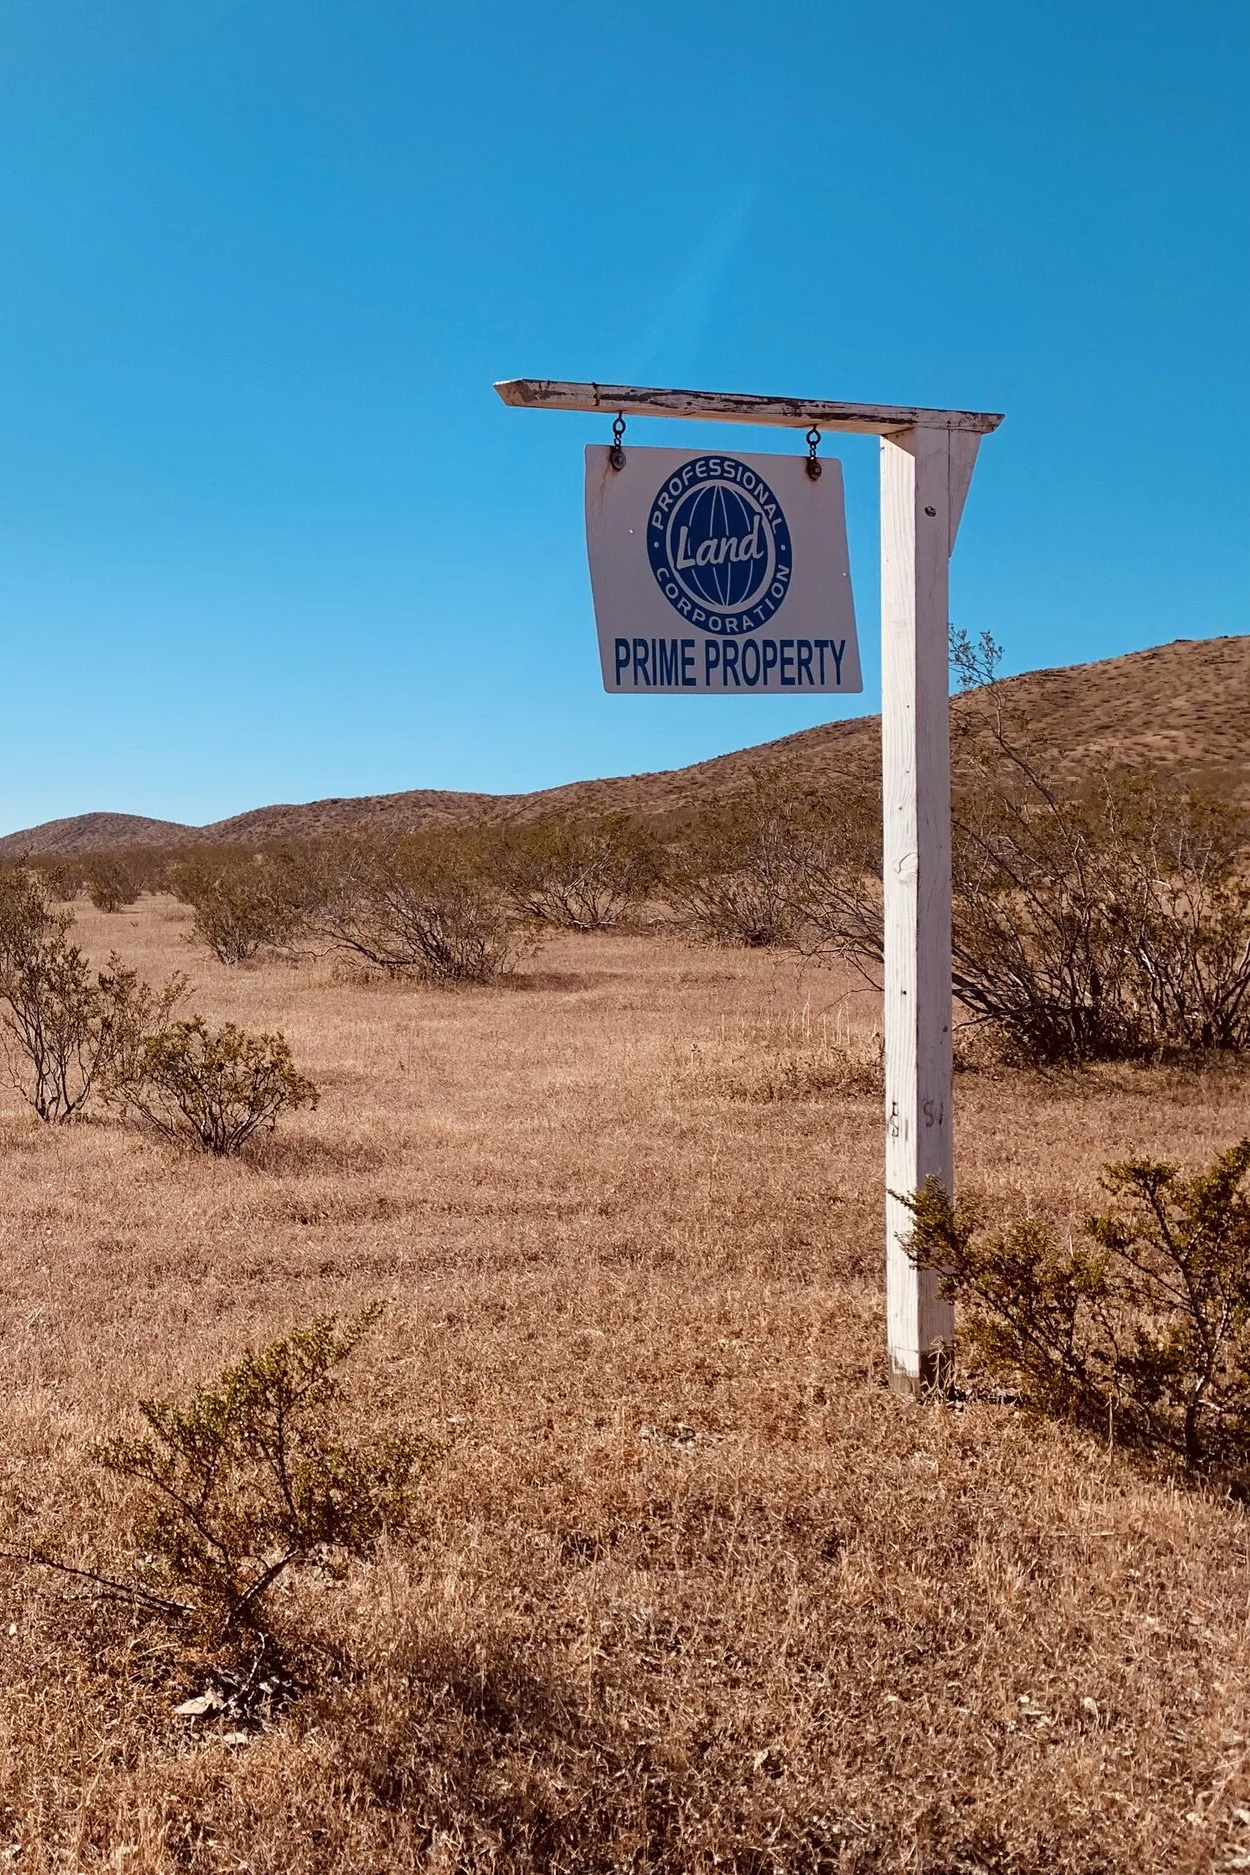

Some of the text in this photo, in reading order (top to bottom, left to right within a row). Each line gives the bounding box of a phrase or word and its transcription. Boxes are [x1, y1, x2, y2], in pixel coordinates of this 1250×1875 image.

[652, 458, 785, 534] PROFESSIONAL
[676, 514, 764, 570] Land
[656, 564, 790, 633] CORPORATION
[614, 638, 846, 686] PRIME PROPERTY
